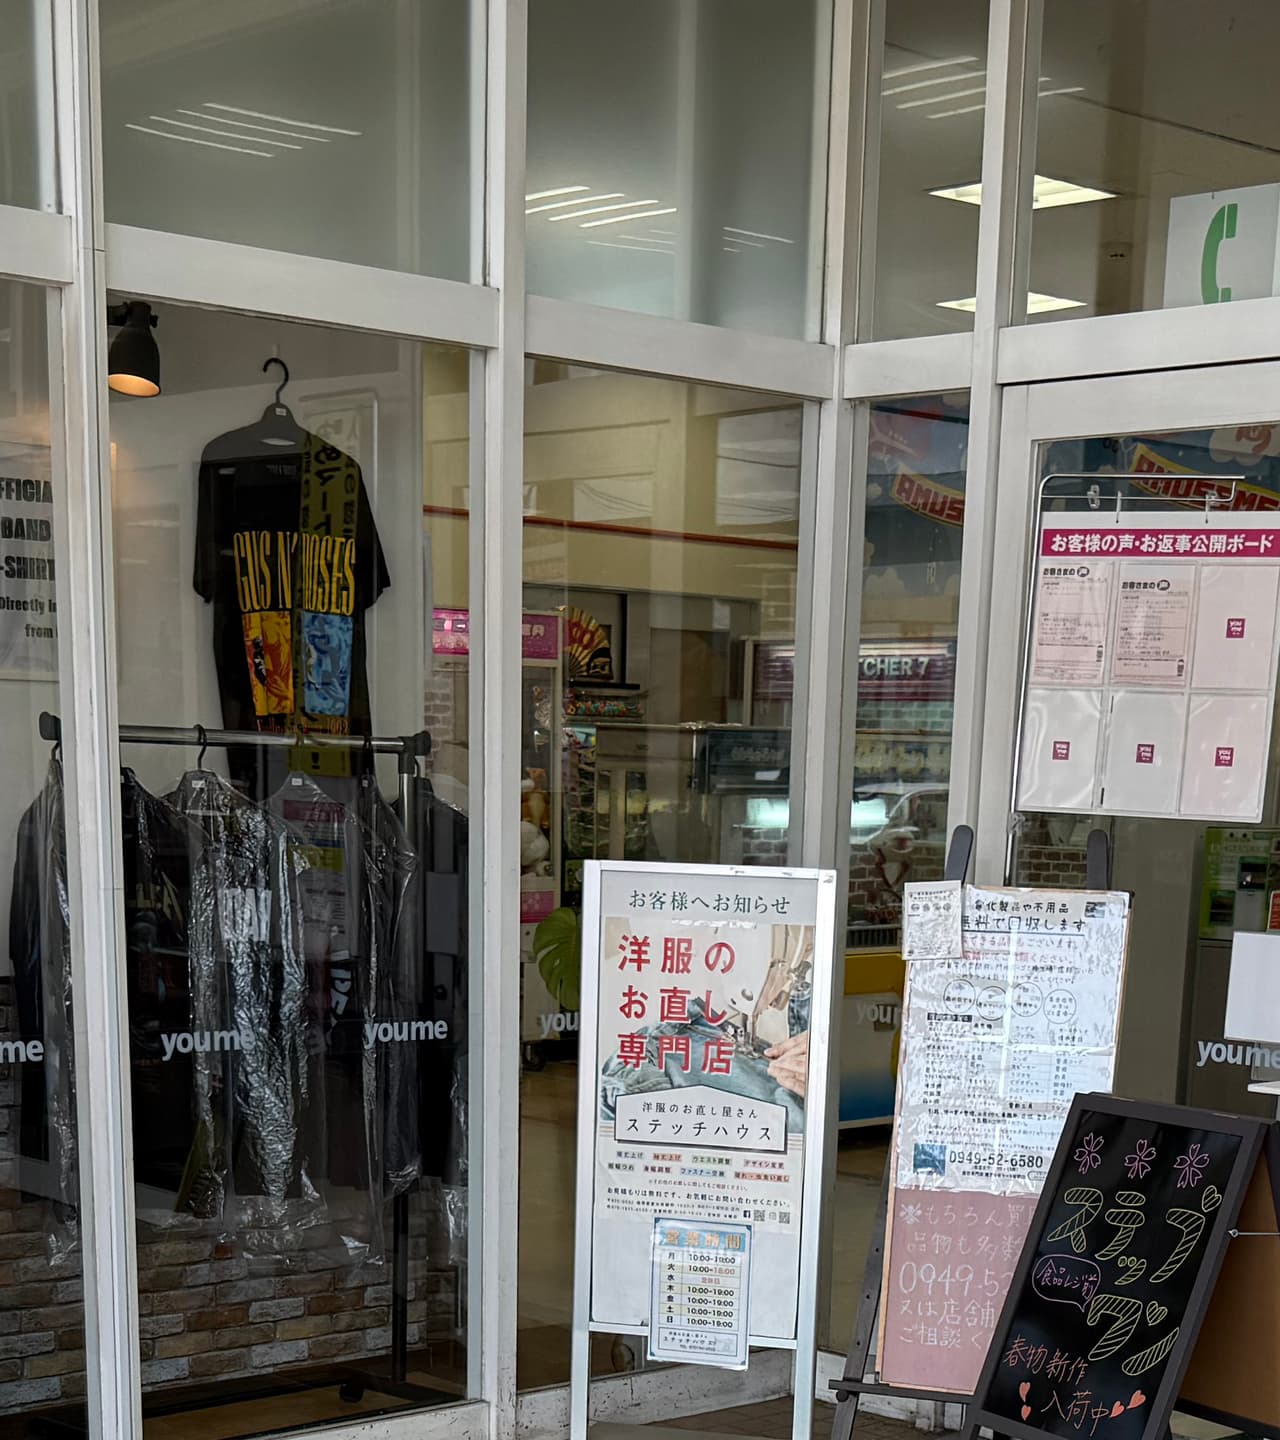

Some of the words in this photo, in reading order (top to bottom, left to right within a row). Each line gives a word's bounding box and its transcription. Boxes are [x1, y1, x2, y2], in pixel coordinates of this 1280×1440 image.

[1, 517, 51, 542] BAND
[1051, 532, 1275, 554] お客様の声・お返事公開ボード
[25, 624, 53, 639] from
[629, 888, 791, 915] お客様へお知らせ
[618, 934, 736, 974] 洋服の
[618, 984, 730, 1027] お直し
[616, 1031, 736, 1075] 専門店
[641, 1101, 758, 1119] 洋服のお直し屋さん
[626, 1118, 771, 1141] ステッチハウス
[949, 1151, 1044, 1168] 0949-52-6580
[1003, 1335, 1089, 1385] 春物新作
[1044, 1390, 1111, 1437] 入荷中
